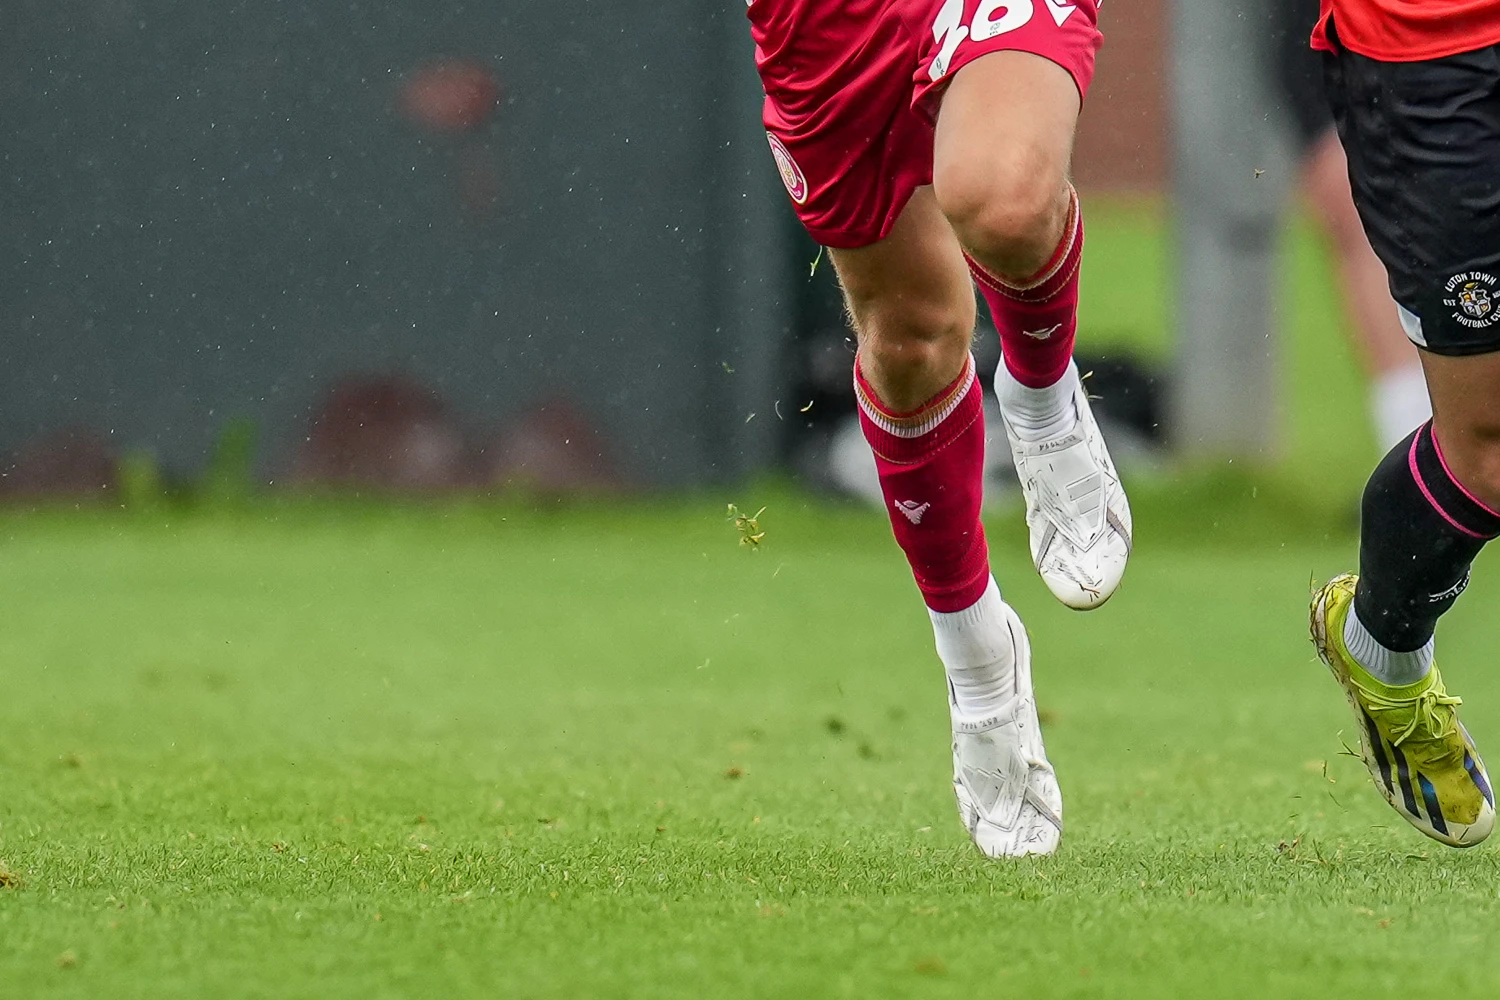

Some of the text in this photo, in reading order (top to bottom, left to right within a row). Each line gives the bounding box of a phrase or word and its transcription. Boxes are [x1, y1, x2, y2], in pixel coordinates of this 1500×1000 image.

[1444, 271, 1497, 293] LUTON TOWN
[1451, 311, 1492, 329] FOOTBALL
